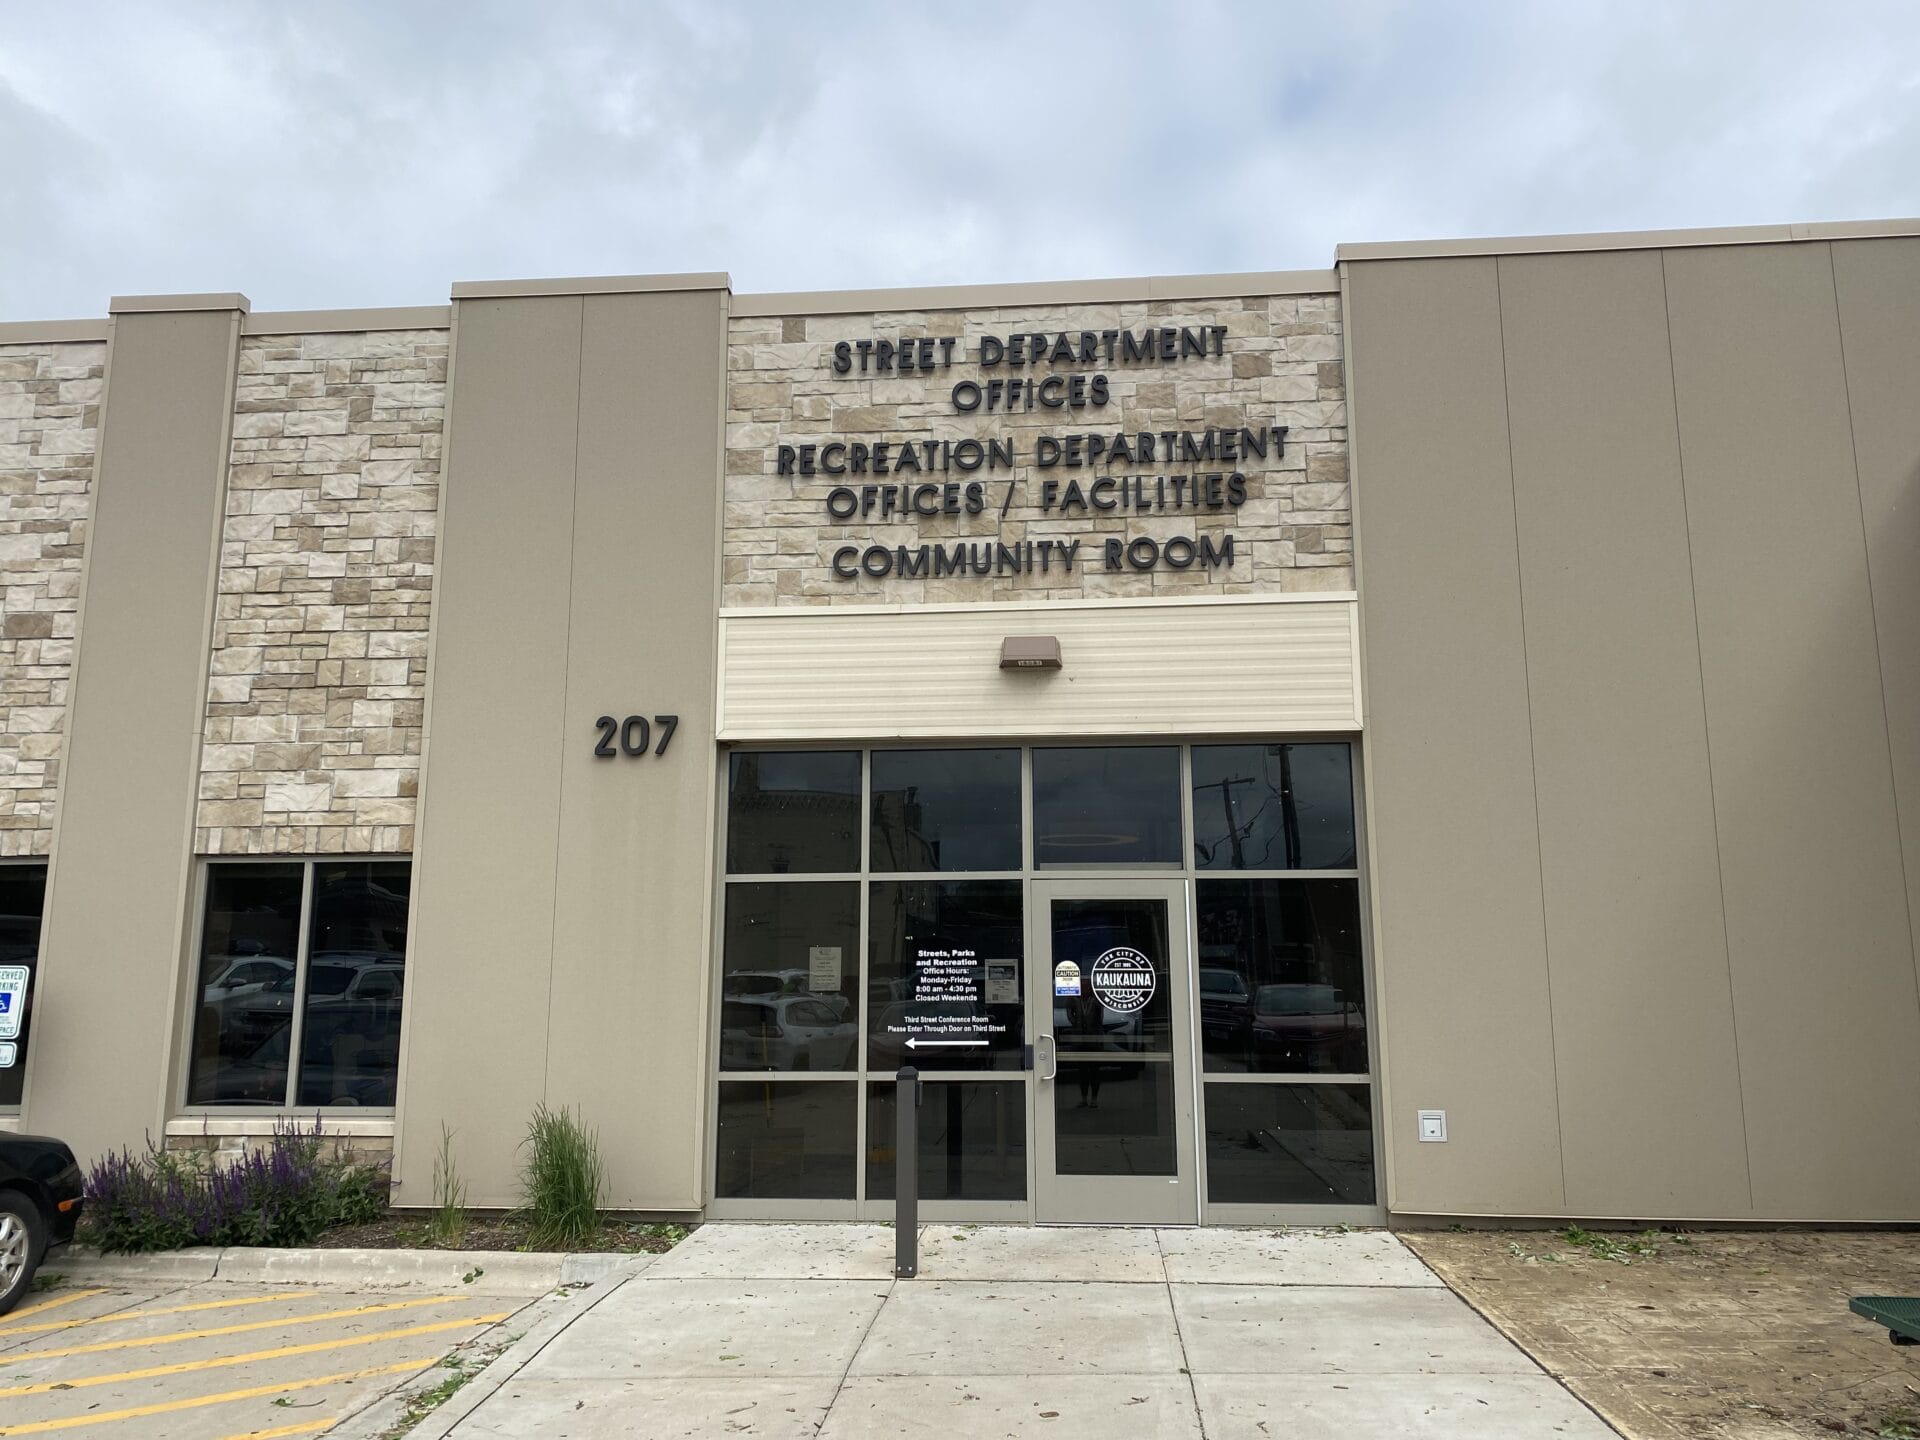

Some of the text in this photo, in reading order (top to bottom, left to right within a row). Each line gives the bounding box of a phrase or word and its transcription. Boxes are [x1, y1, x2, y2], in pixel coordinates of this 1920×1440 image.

[834, 325, 1228, 373] STREET DEPARTMENT
[952, 374, 1110, 410] OFFICES
[778, 426, 1289, 475] RECREATION DEPARTMENT
[827, 473, 1247, 518] OFFICES / FACILITIES
[833, 535, 1235, 577] COMMUNITY ROOM
[594, 715, 678, 756] 207
[1101, 954, 1114, 965] THE
[1136, 956, 1145, 965] OF
[1096, 973, 1151, 986] KAUKAUNA
[1103, 997, 1145, 1008] WISCONSIN
[924, 1026, 948, 1034] Through
